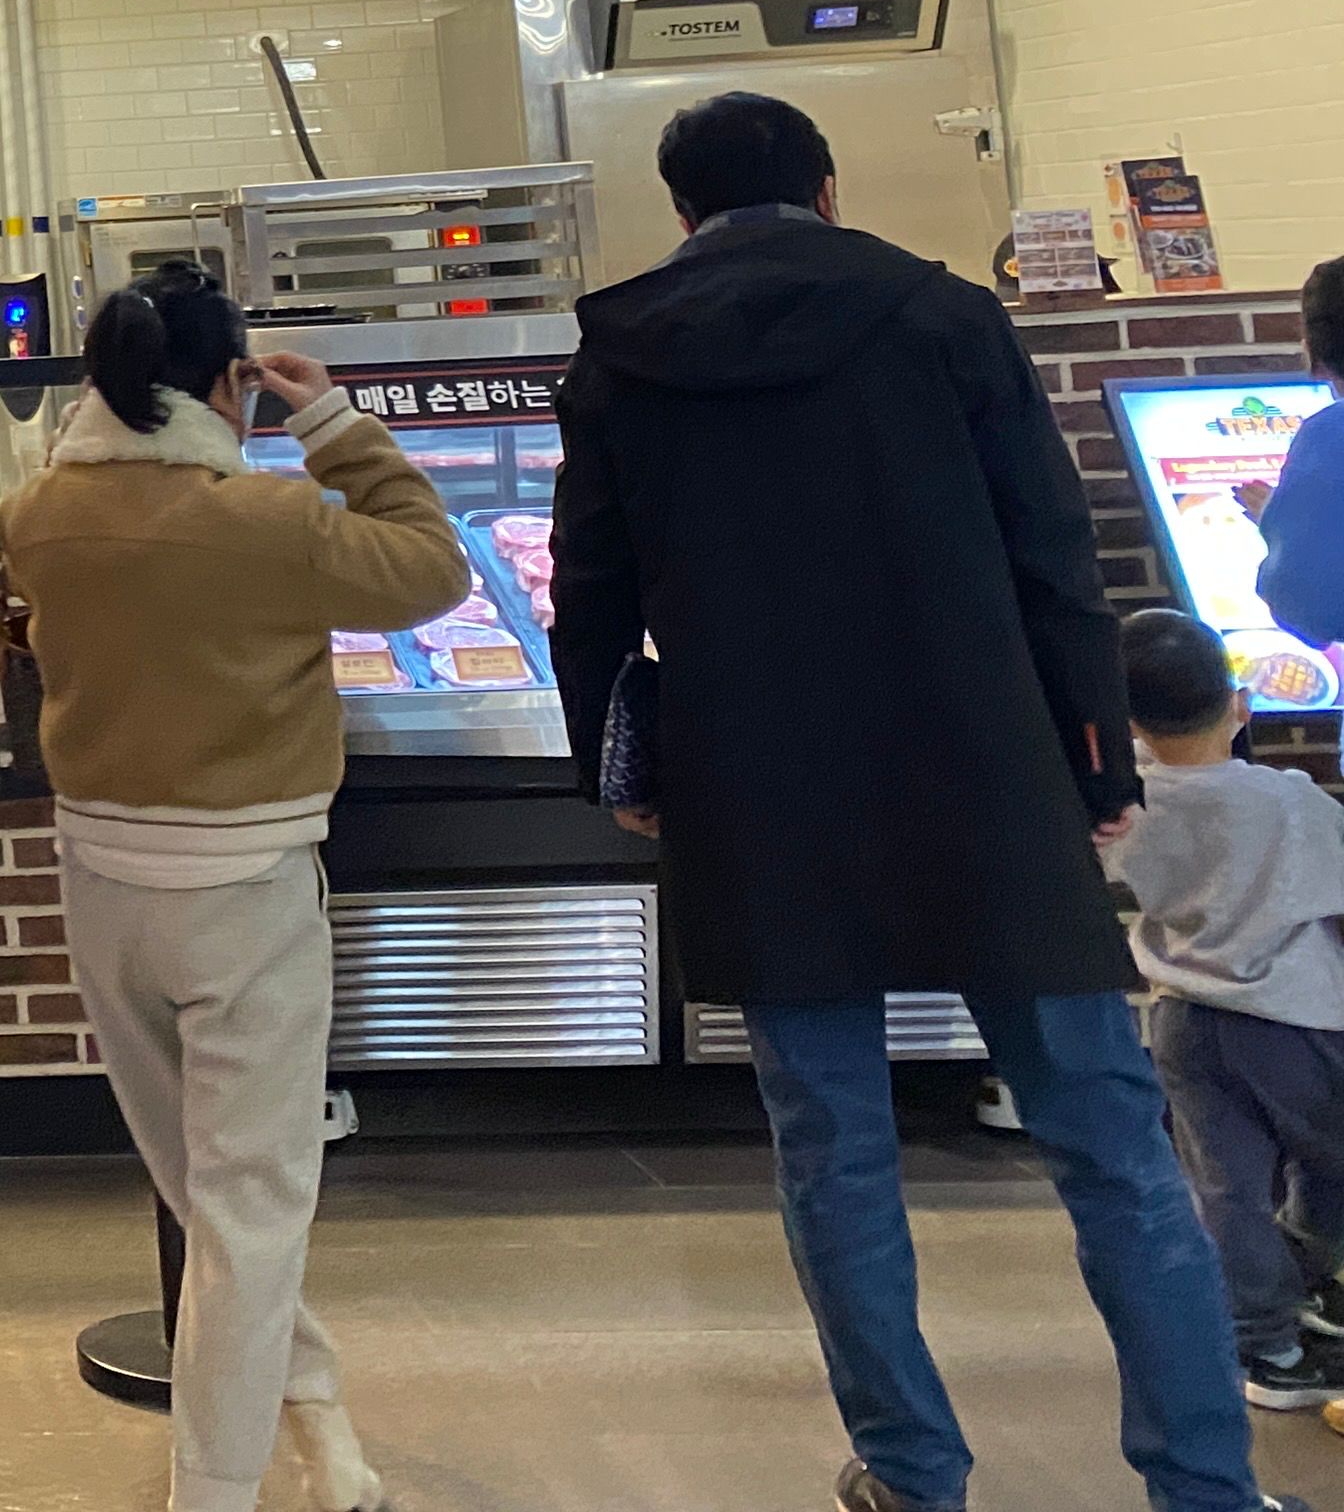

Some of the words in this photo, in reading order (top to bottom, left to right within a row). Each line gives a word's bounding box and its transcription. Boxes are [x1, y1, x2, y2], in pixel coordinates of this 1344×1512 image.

[669, 19, 740, 37] TOSTEM
[355, 385, 420, 416] 매일
[426, 380, 552, 413] 손질하는
